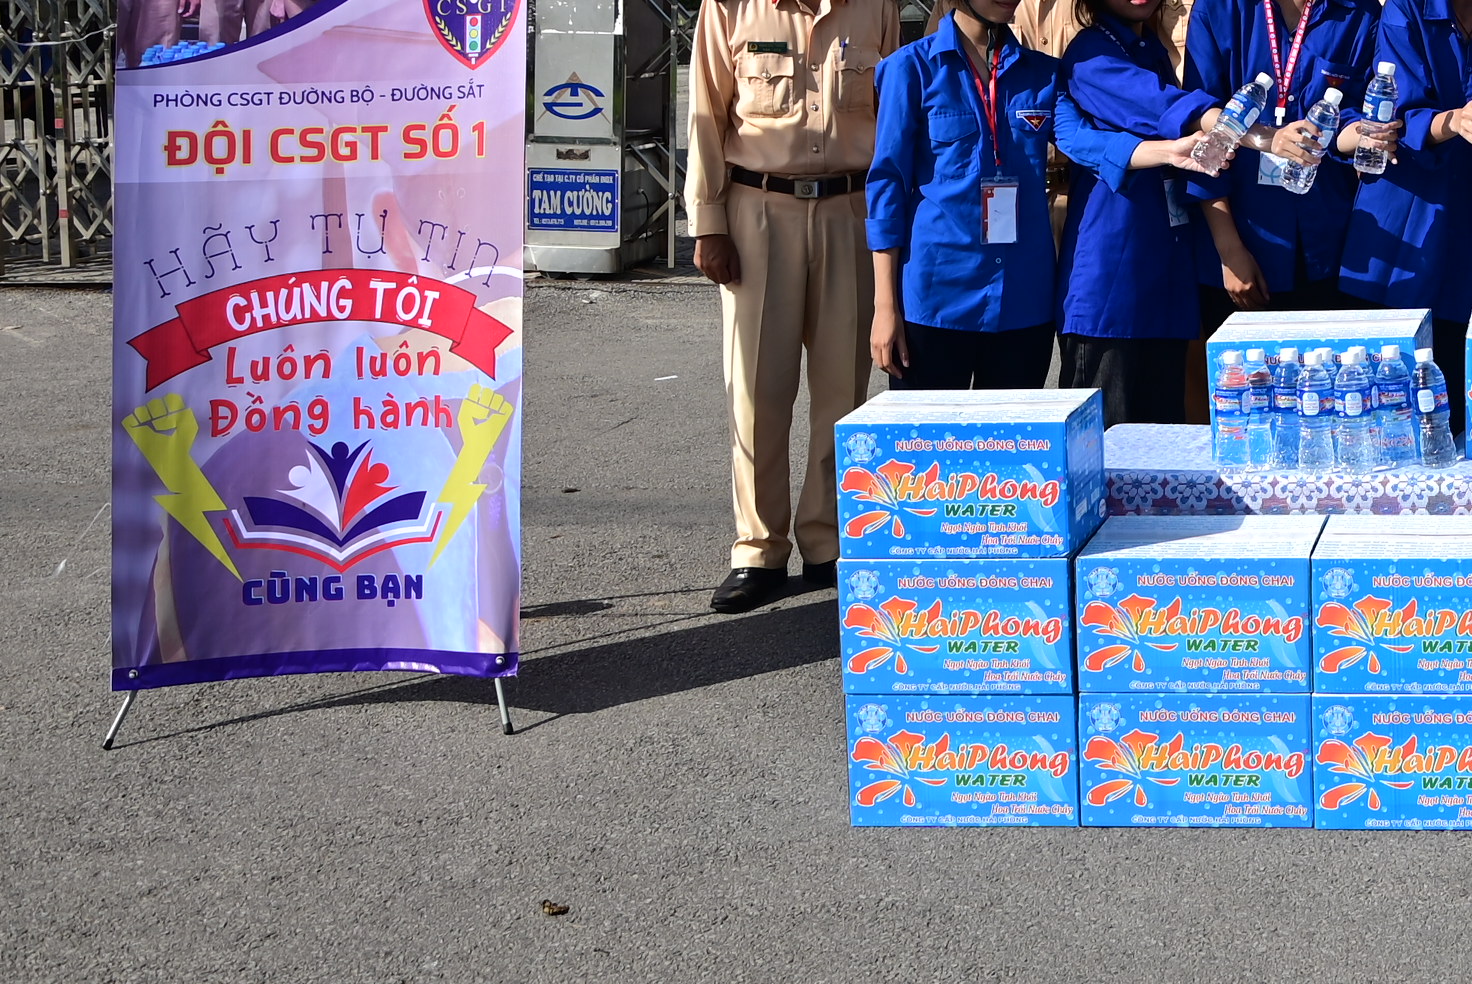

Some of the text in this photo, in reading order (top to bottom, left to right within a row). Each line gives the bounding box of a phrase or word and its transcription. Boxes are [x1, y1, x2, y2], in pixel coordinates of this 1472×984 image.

[153, 86, 222, 108] PHÒNG
[227, 92, 272, 107] CSGT
[278, 85, 346, 106] ĐƯỜNG
[350, 89, 375, 109] BỘ
[391, 80, 454, 102] ĐƯỜNG
[457, 78, 485, 100] SẮT
[164, 104, 487, 174] ĐỘI CSGT SỐ 1
[532, 184, 612, 216] TAM CƯỜNG
[144, 219, 281, 298] HÃY
[310, 209, 389, 261] TỰ
[226, 276, 440, 331] CHÚNG TÔI
[225, 341, 441, 386] Luôn luôn
[209, 392, 454, 437] Đồng hành
[895, 436, 1050, 452] NƯỚC UỐNG ĐÓNG CHAI
[895, 470, 1059, 508] HaiPhong
[944, 504, 1017, 517] WATER
[356, 574, 424, 608] BẠN
[1137, 572, 1294, 587] NƯỚC UỐNG ĐÓNG CHAI
[1373, 574, 1410, 588] NƯỚC
[1414, 572, 1453, 587] UỐNG
[897, 608, 1062, 644] HaiPhong
[1136, 606, 1302, 643] HaiPhong
[947, 640, 1020, 653] WATER
[1186, 639, 1259, 652] WATER
[906, 708, 1060, 723] NƯỚC UỐNG ĐÓNG CHAI
[1373, 711, 1410, 725] NƯỚC
[1414, 710, 1453, 724] UỐNG
[905, 742, 1069, 777] HaiPhong
[1138, 741, 1304, 778] HaiPhong
[954, 774, 1027, 786] WATER
[1187, 774, 1261, 787] WATER
